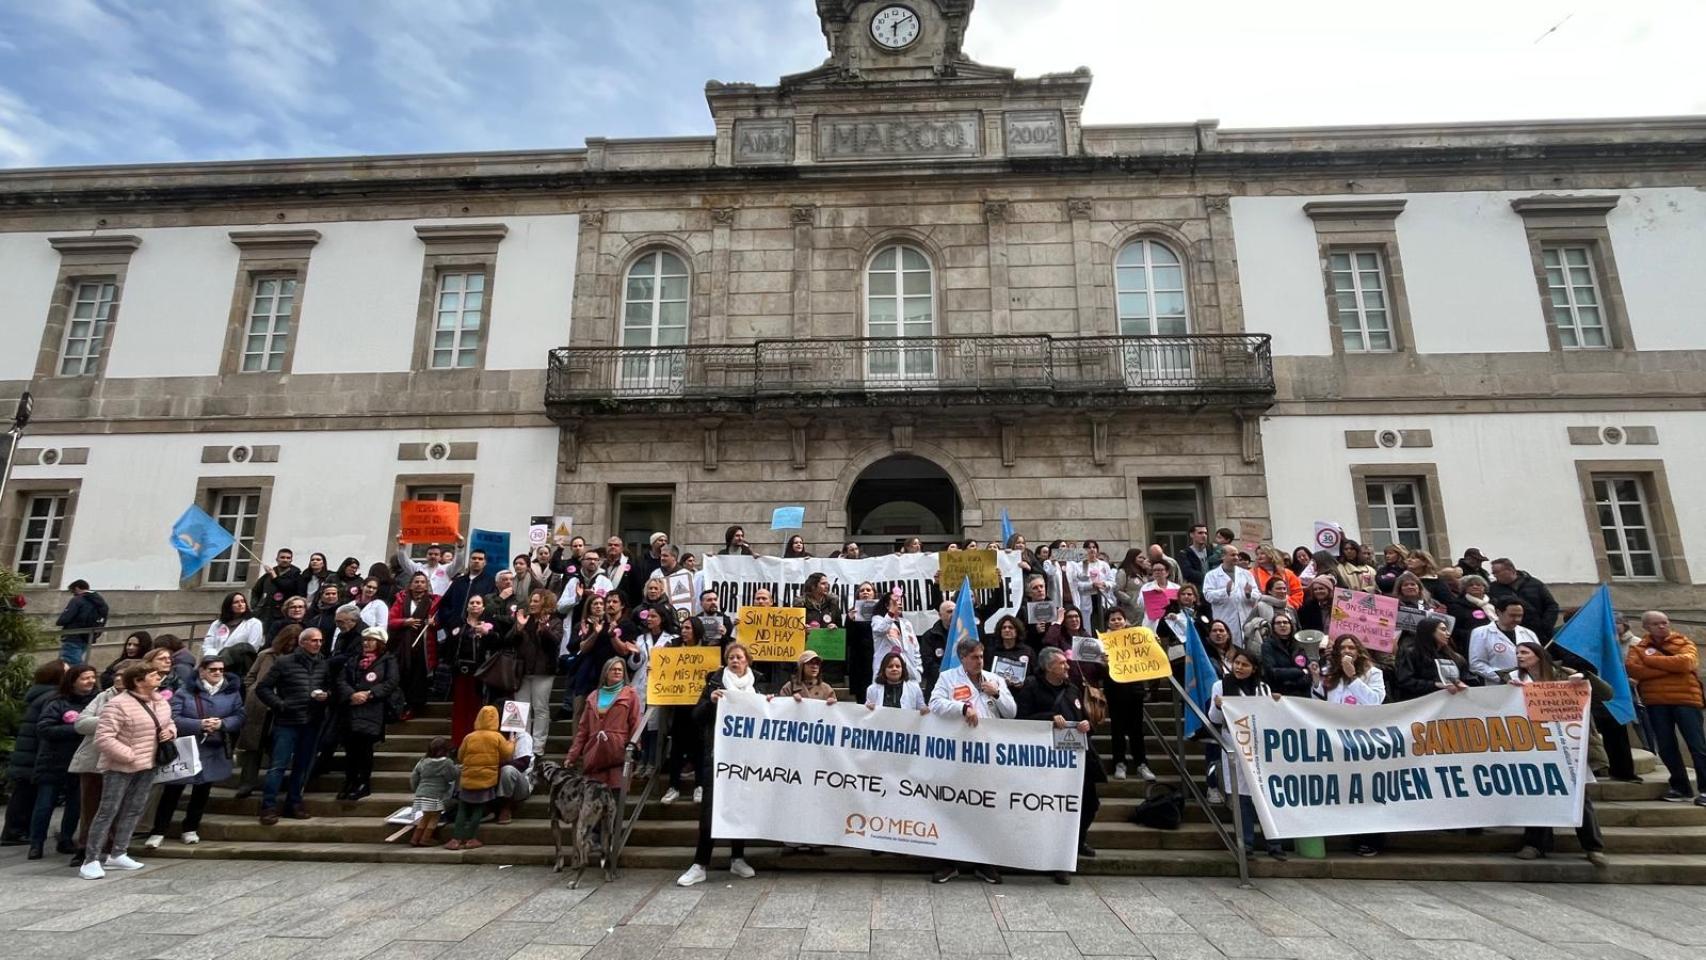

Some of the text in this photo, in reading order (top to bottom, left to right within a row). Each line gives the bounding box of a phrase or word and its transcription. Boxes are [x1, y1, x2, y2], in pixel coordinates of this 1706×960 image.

[1009, 126, 1058, 144] 2002
[744, 609, 806, 631] SIN MÉDICOS
[755, 629, 794, 642] NO HAY
[749, 643, 796, 657] SANIDAD
[1116, 645, 1151, 660] NO HAY
[658, 654, 671, 666] YO
[1114, 661, 1160, 675] SANIDAD
[659, 671, 666, 680] A
[722, 715, 1078, 769] SEN ATENCIÓN PRIMARIA NON HAI SANIDADE
[1263, 728, 1334, 762] POLA
[1337, 726, 1406, 762] NOSA
[1411, 715, 1557, 757] SANIDADE
[716, 762, 1079, 812] PRIMARIA FORTE, SANIDADE FORTE
[1268, 774, 1340, 808] COIDA
[1349, 773, 1364, 804] A
[1372, 767, 1433, 805] QUEN
[1435, 765, 1469, 798] TE
[1473, 763, 1568, 796] COIDA
